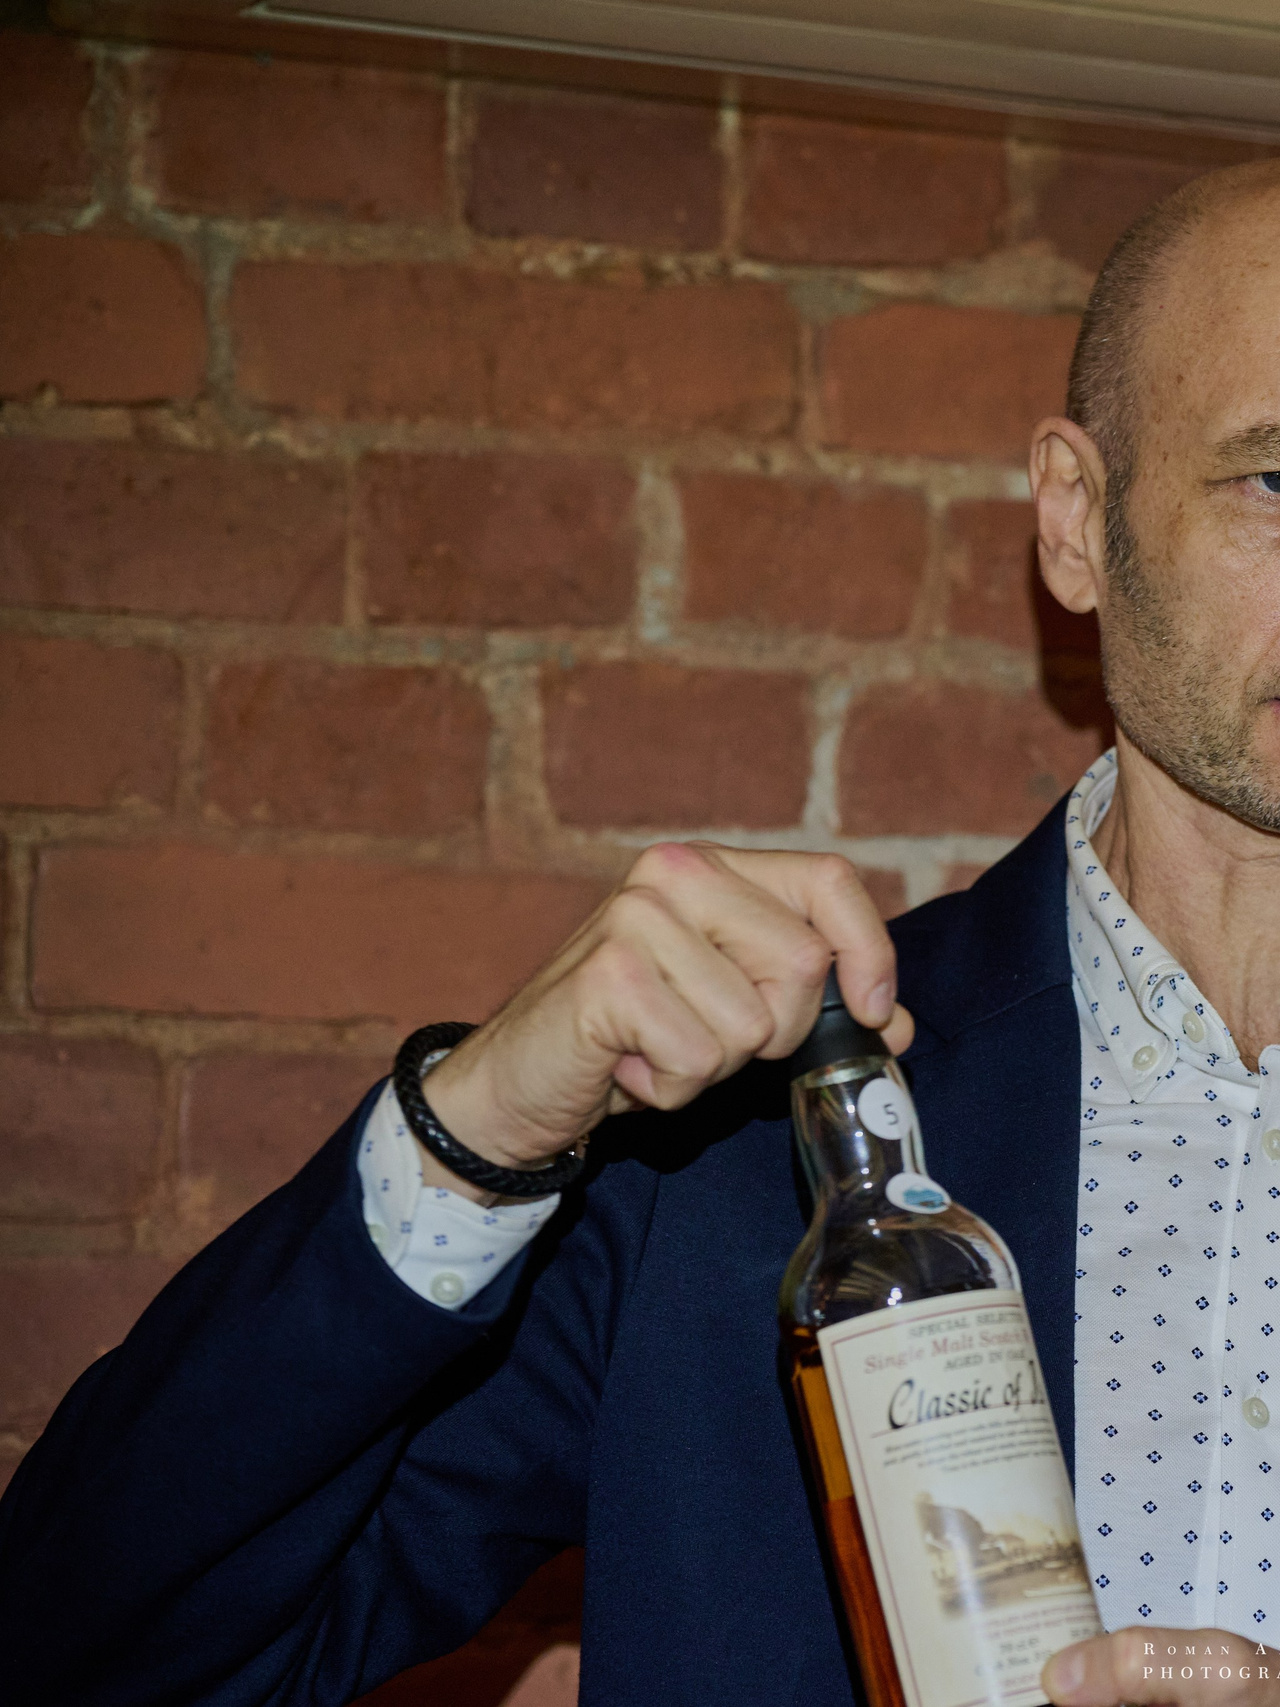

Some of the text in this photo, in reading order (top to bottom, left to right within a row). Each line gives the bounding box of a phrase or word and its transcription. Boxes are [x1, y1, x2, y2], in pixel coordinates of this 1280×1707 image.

[882, 1103, 899, 1126] 5
[864, 1348, 925, 1374] Single
[931, 1336, 974, 1357] Malt
[888, 1378, 992, 1430] Classic
[1003, 1371, 1022, 1413] of
